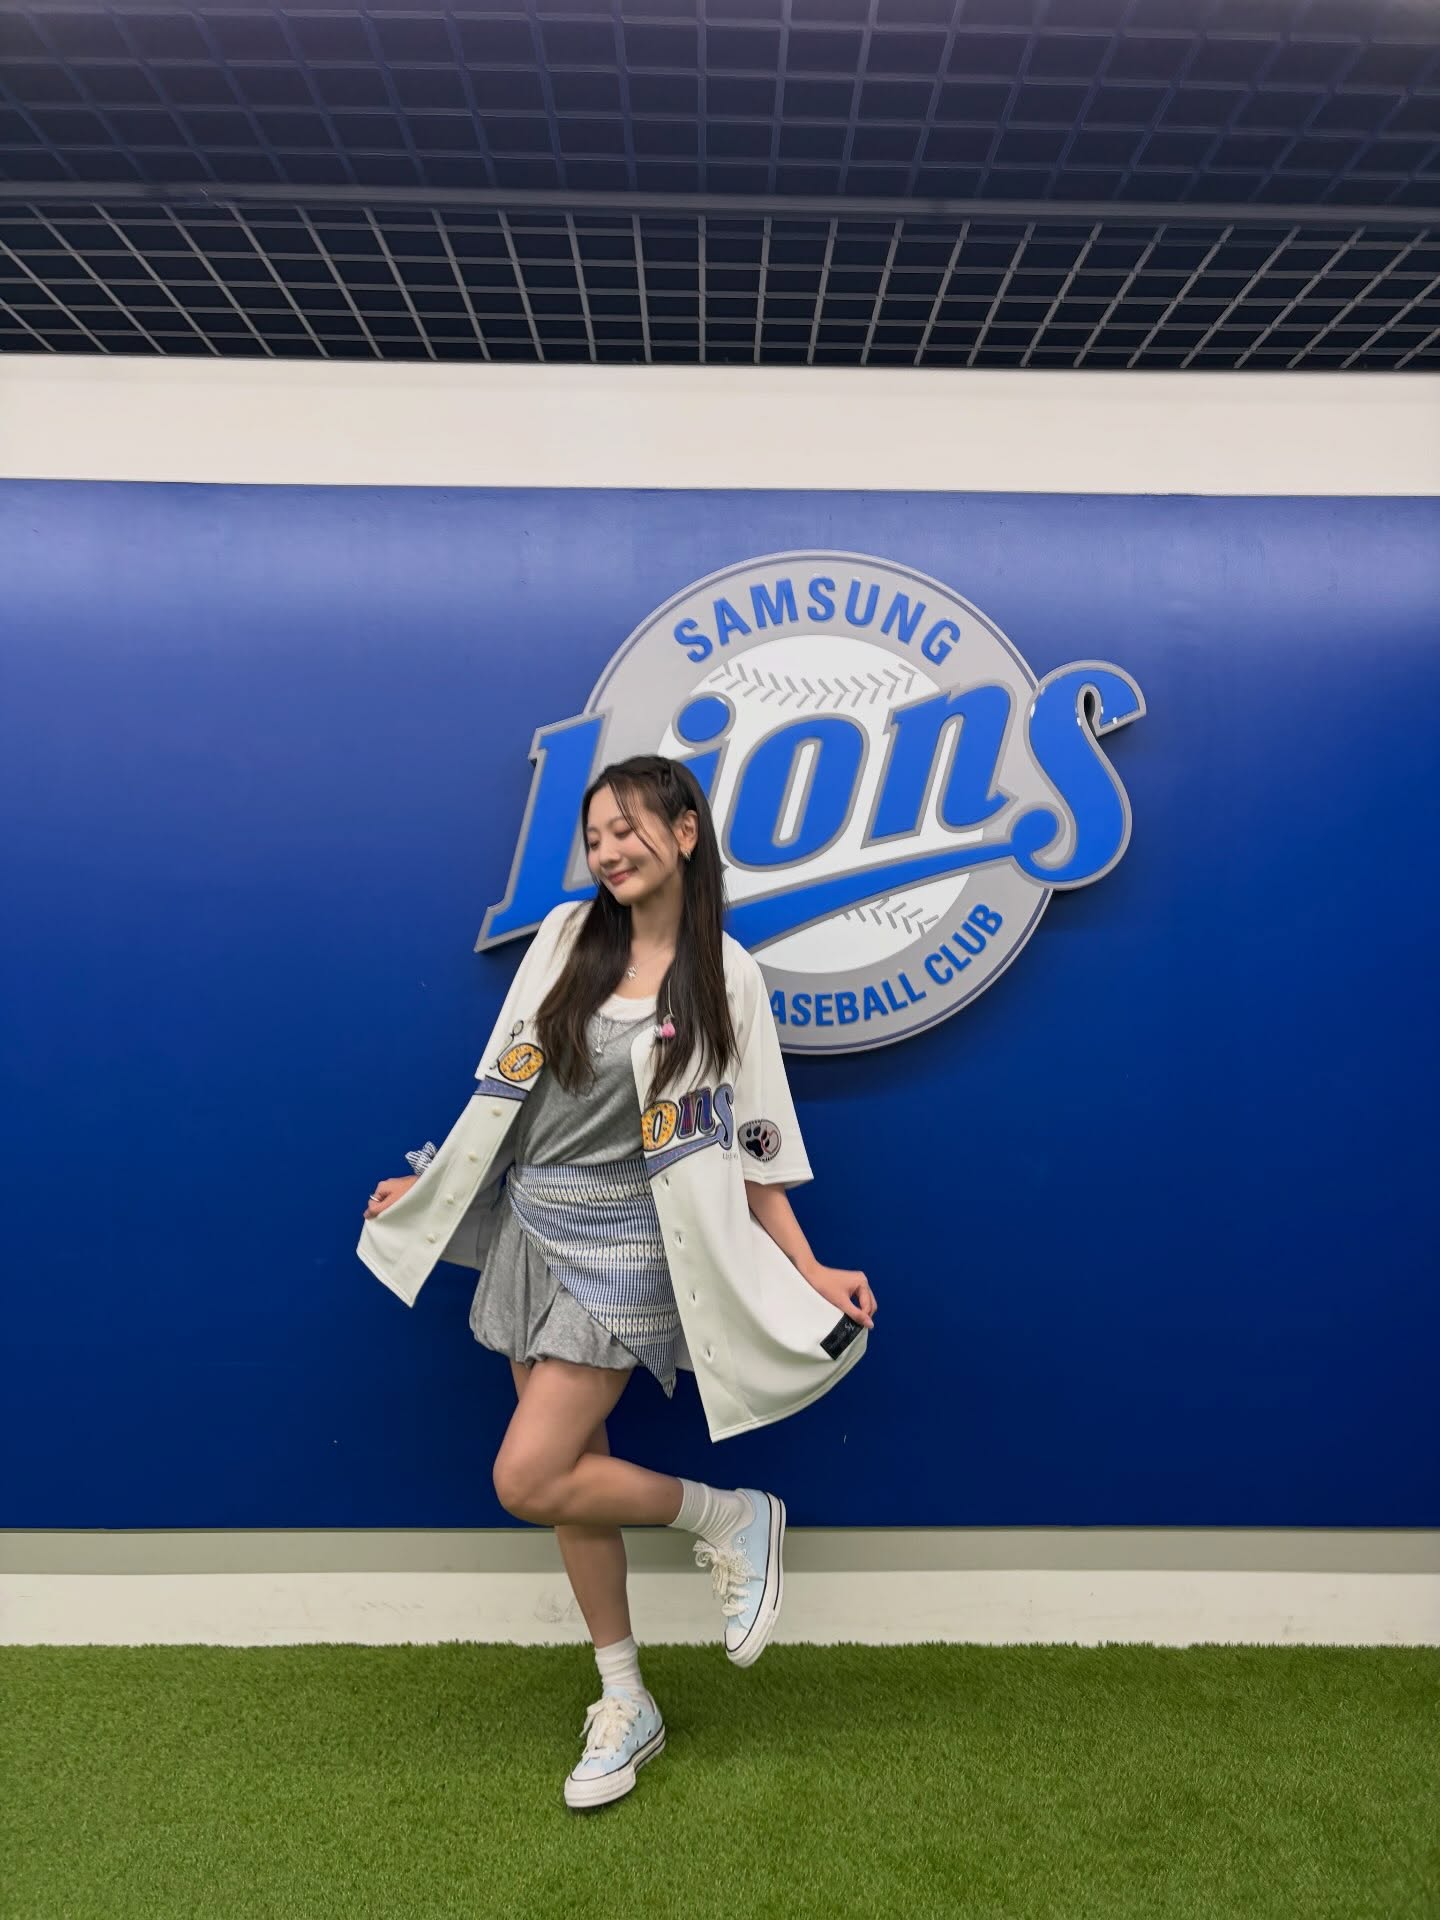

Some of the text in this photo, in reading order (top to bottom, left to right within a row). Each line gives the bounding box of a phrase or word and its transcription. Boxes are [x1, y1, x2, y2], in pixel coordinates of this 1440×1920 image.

[673, 576, 961, 666] SAMSUNG
[769, 903, 1004, 1027] ASEBALL CLUB
